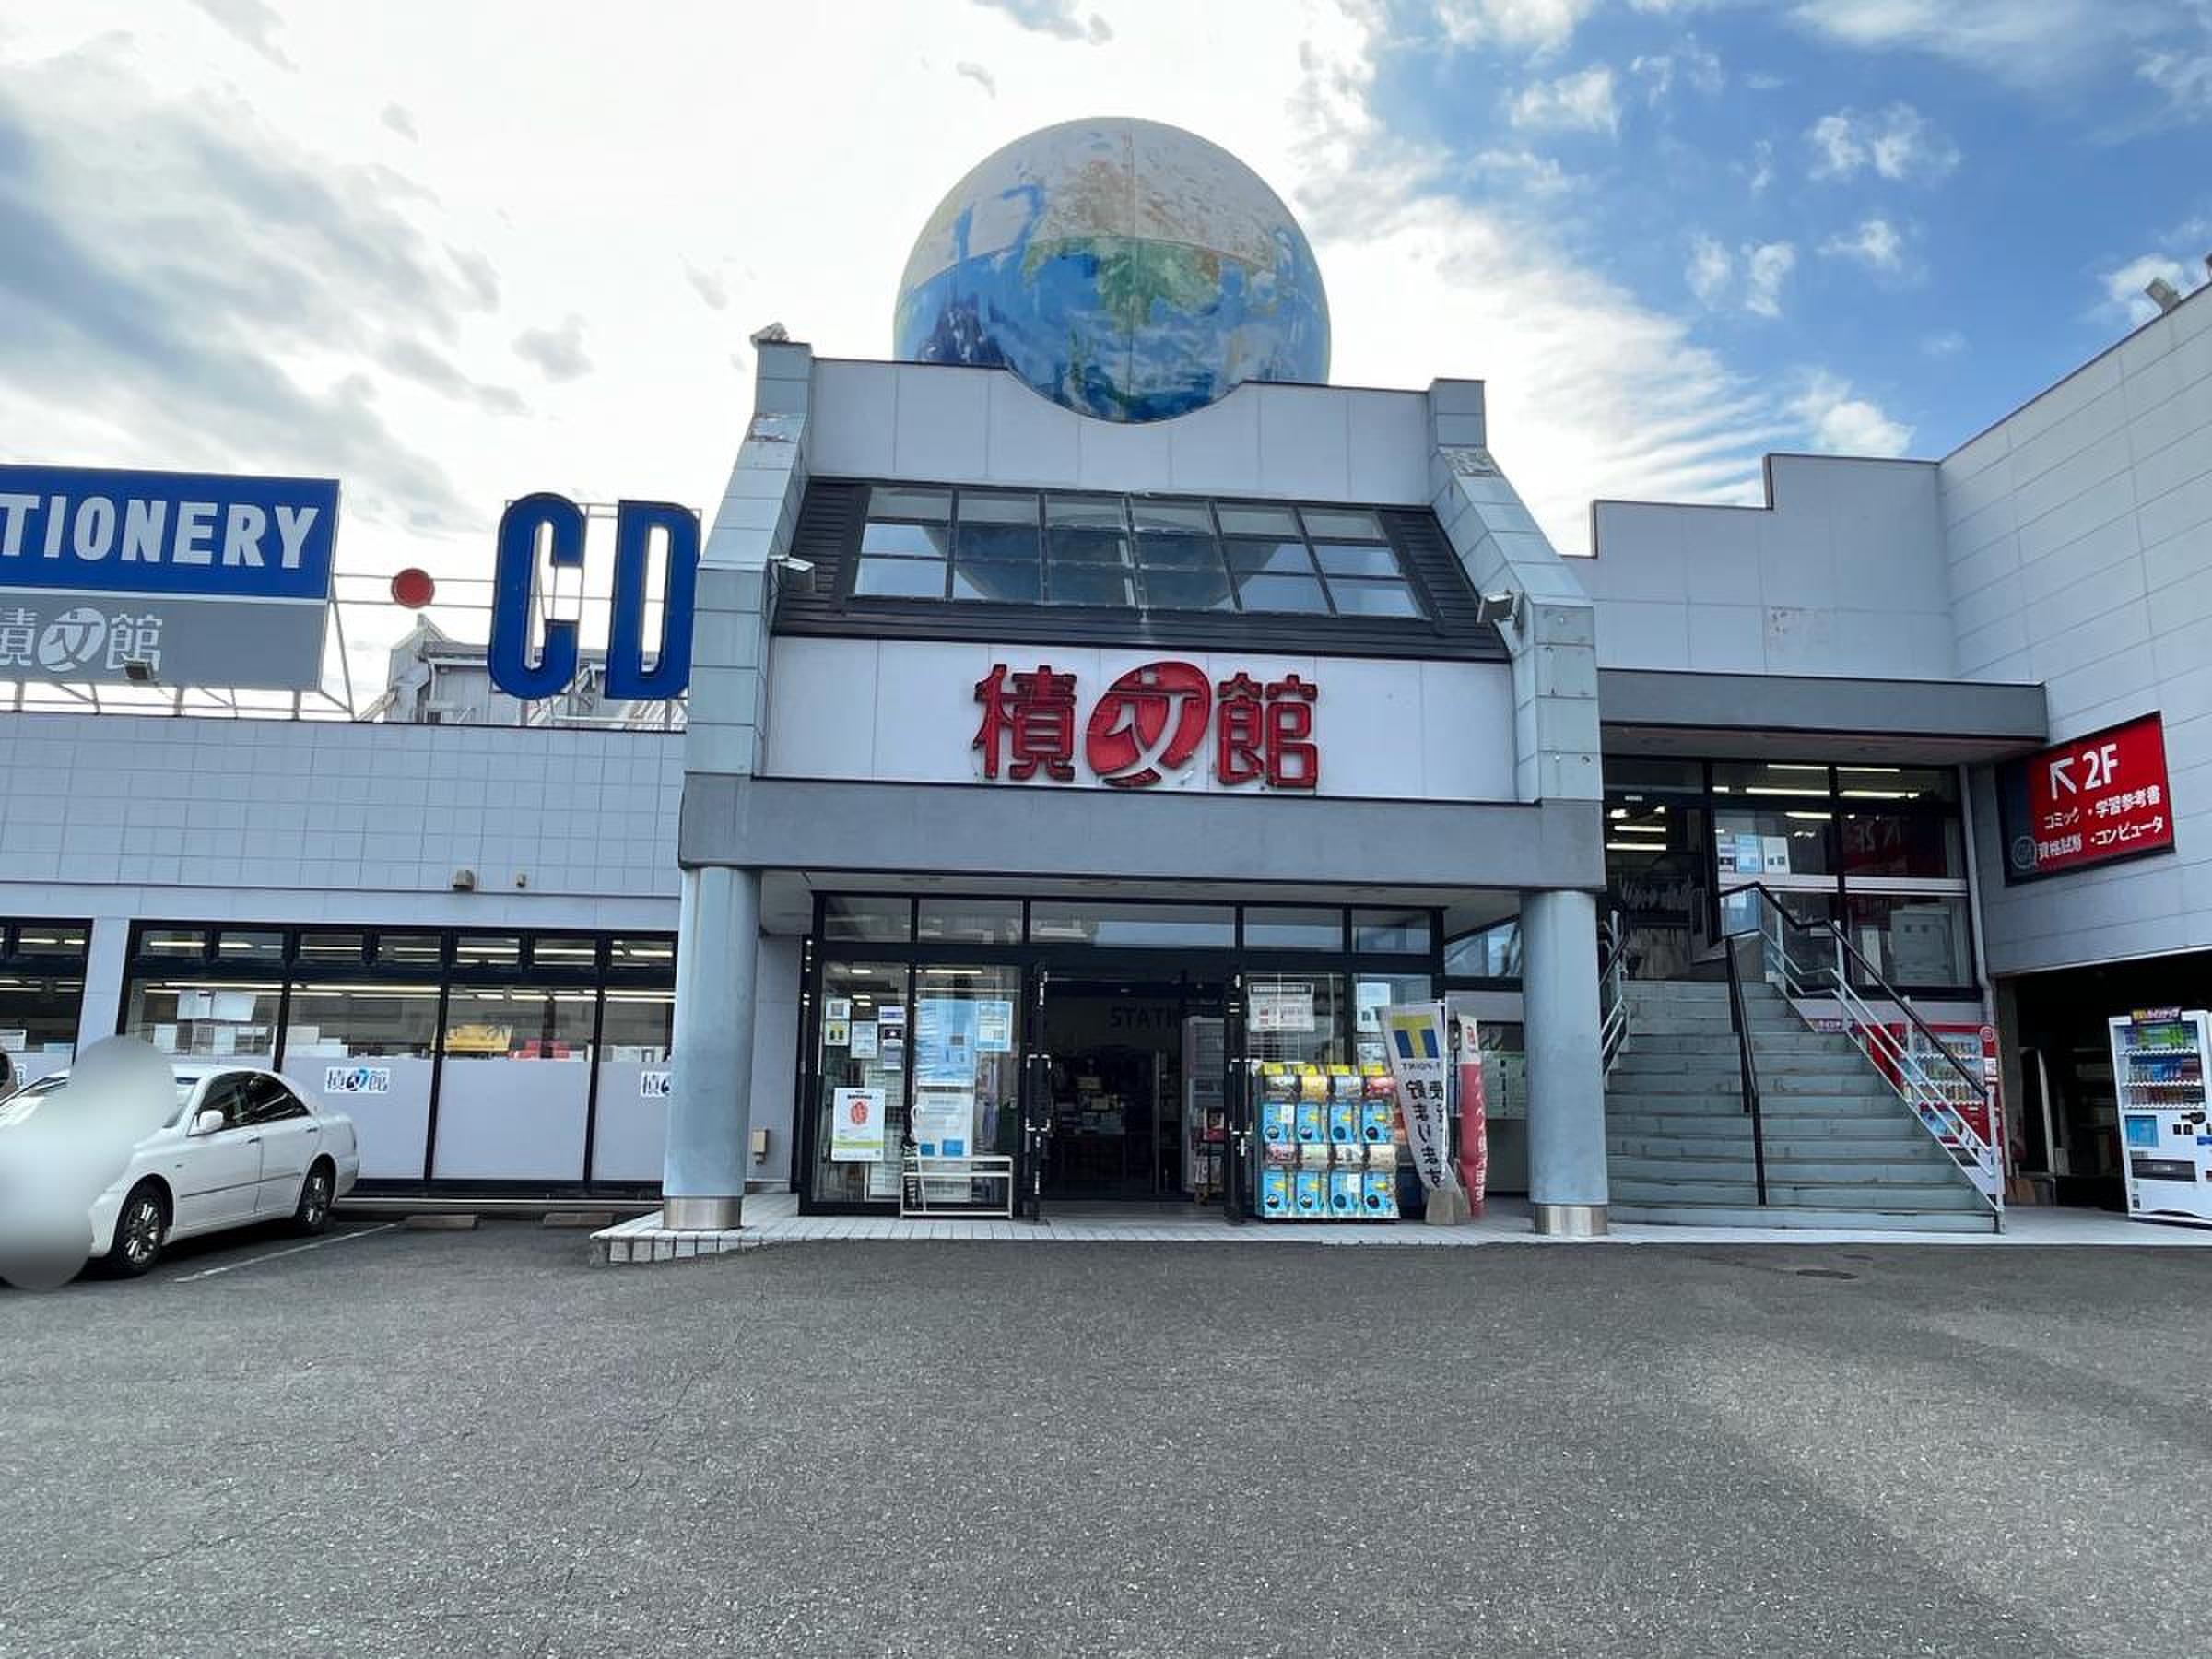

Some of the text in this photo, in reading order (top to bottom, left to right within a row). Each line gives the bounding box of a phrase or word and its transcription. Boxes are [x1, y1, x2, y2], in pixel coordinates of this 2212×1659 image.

[0, 493, 319, 570] TIONERY
[487, 491, 701, 700] CD
[973, 661, 1319, 789] 積文館
[2082, 743, 2119, 791] 2F
